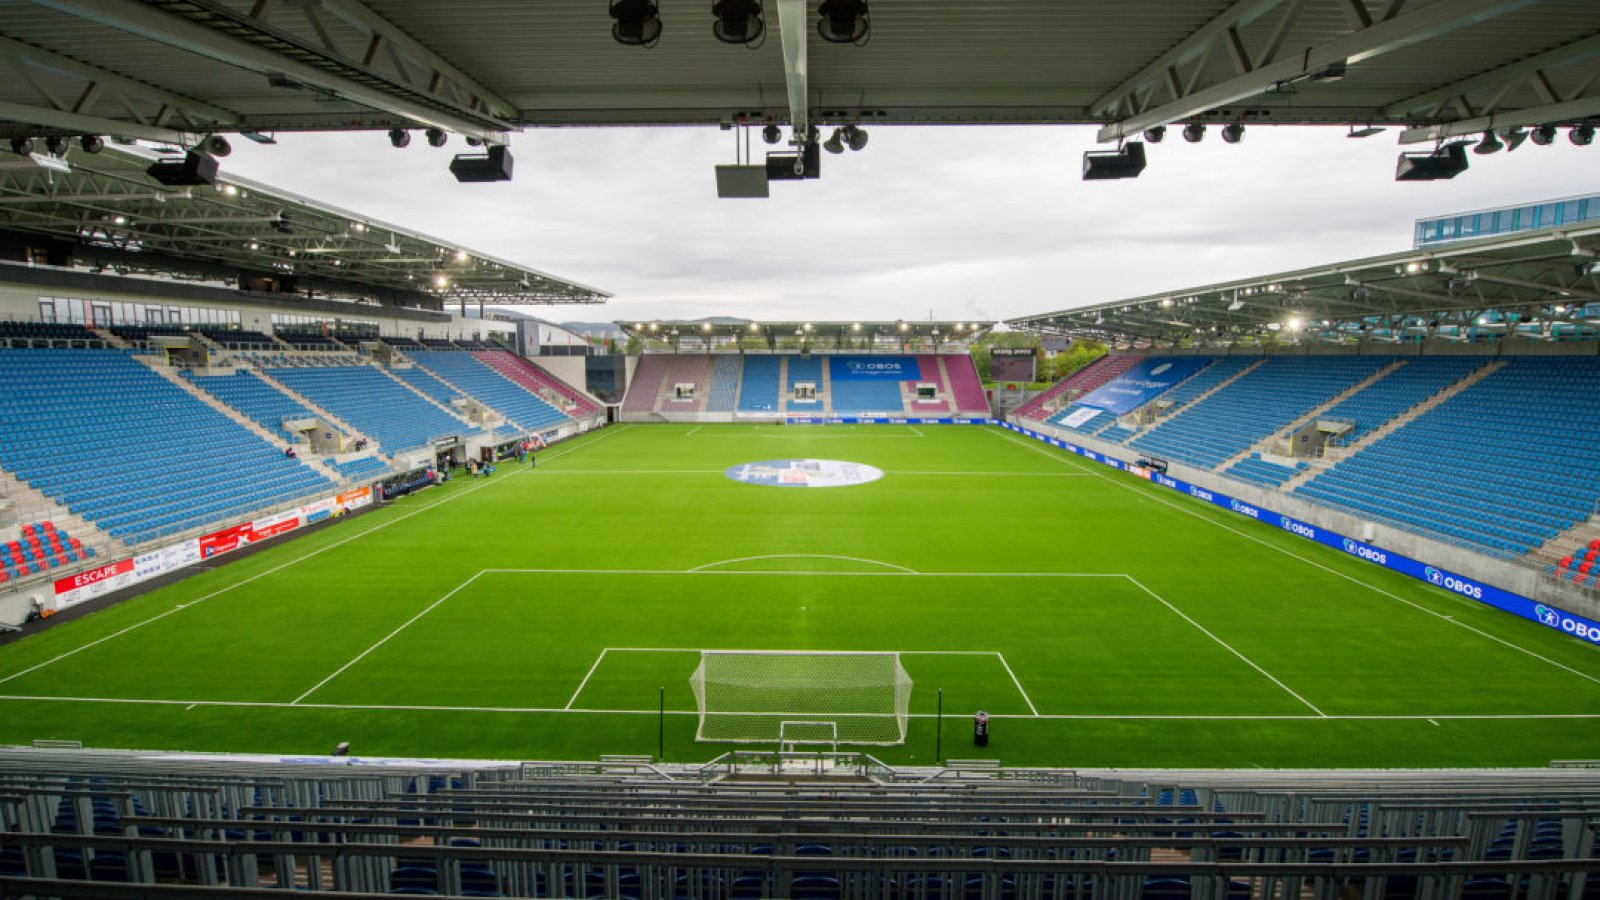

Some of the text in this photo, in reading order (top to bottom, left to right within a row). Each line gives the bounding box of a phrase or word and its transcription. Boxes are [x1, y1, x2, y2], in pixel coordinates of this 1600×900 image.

[1240, 505, 1258, 518] OBOS
[1292, 523, 1314, 538] OBOS
[1358, 546, 1386, 564] OBOS
[74, 565, 118, 586] ESCAPE
[1444, 576, 1482, 599] OBOS
